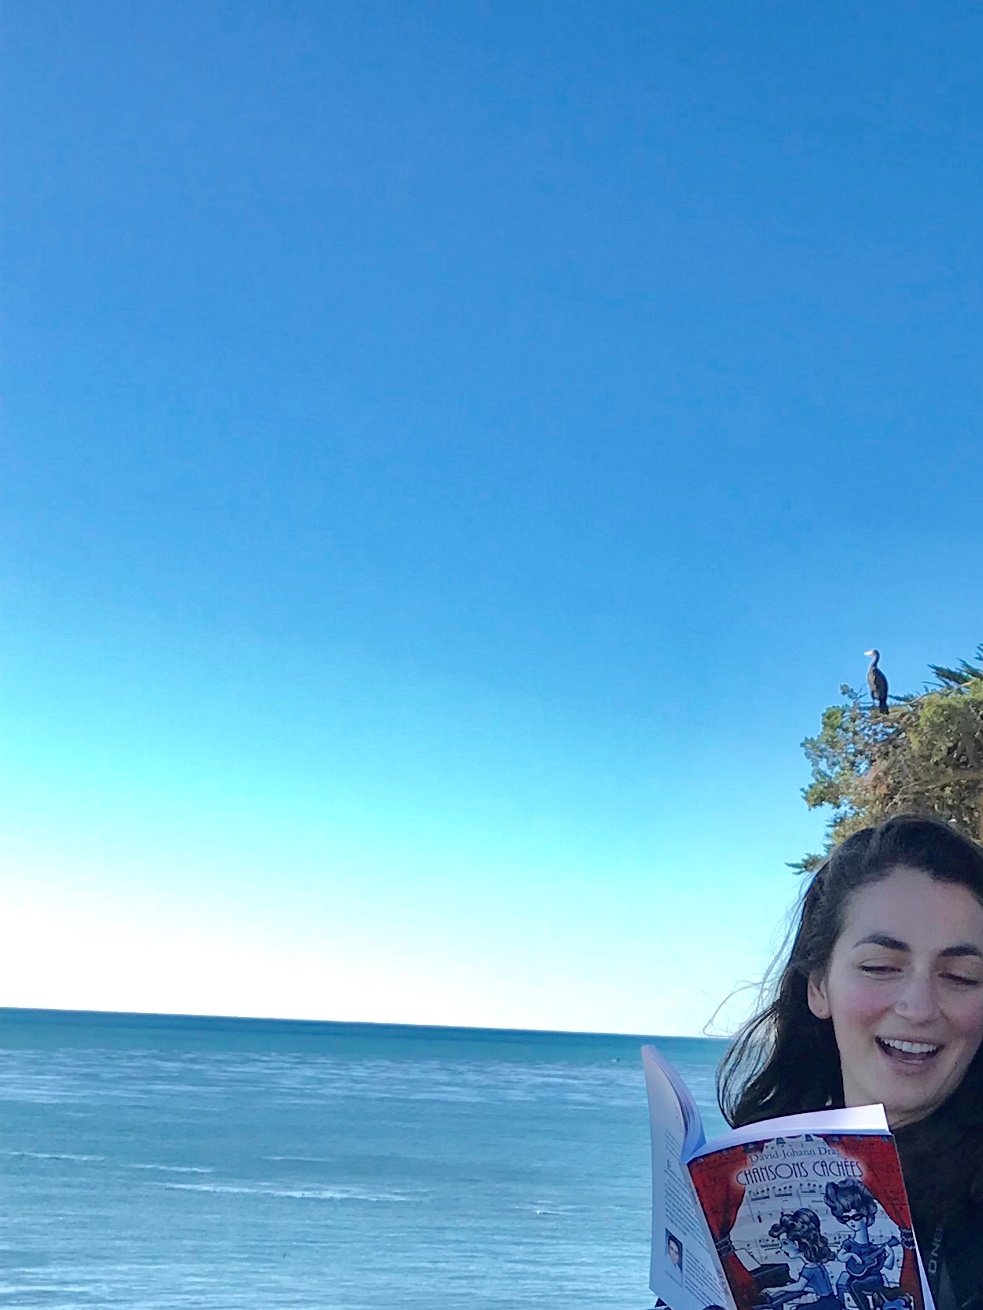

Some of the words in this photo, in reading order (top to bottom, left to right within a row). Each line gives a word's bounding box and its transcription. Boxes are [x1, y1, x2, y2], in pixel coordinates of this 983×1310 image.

[749, 1147, 816, 1163] David-Johann
[735, 1161, 808, 1186] CHANSONS
[812, 1158, 863, 1178] CACHÉES
